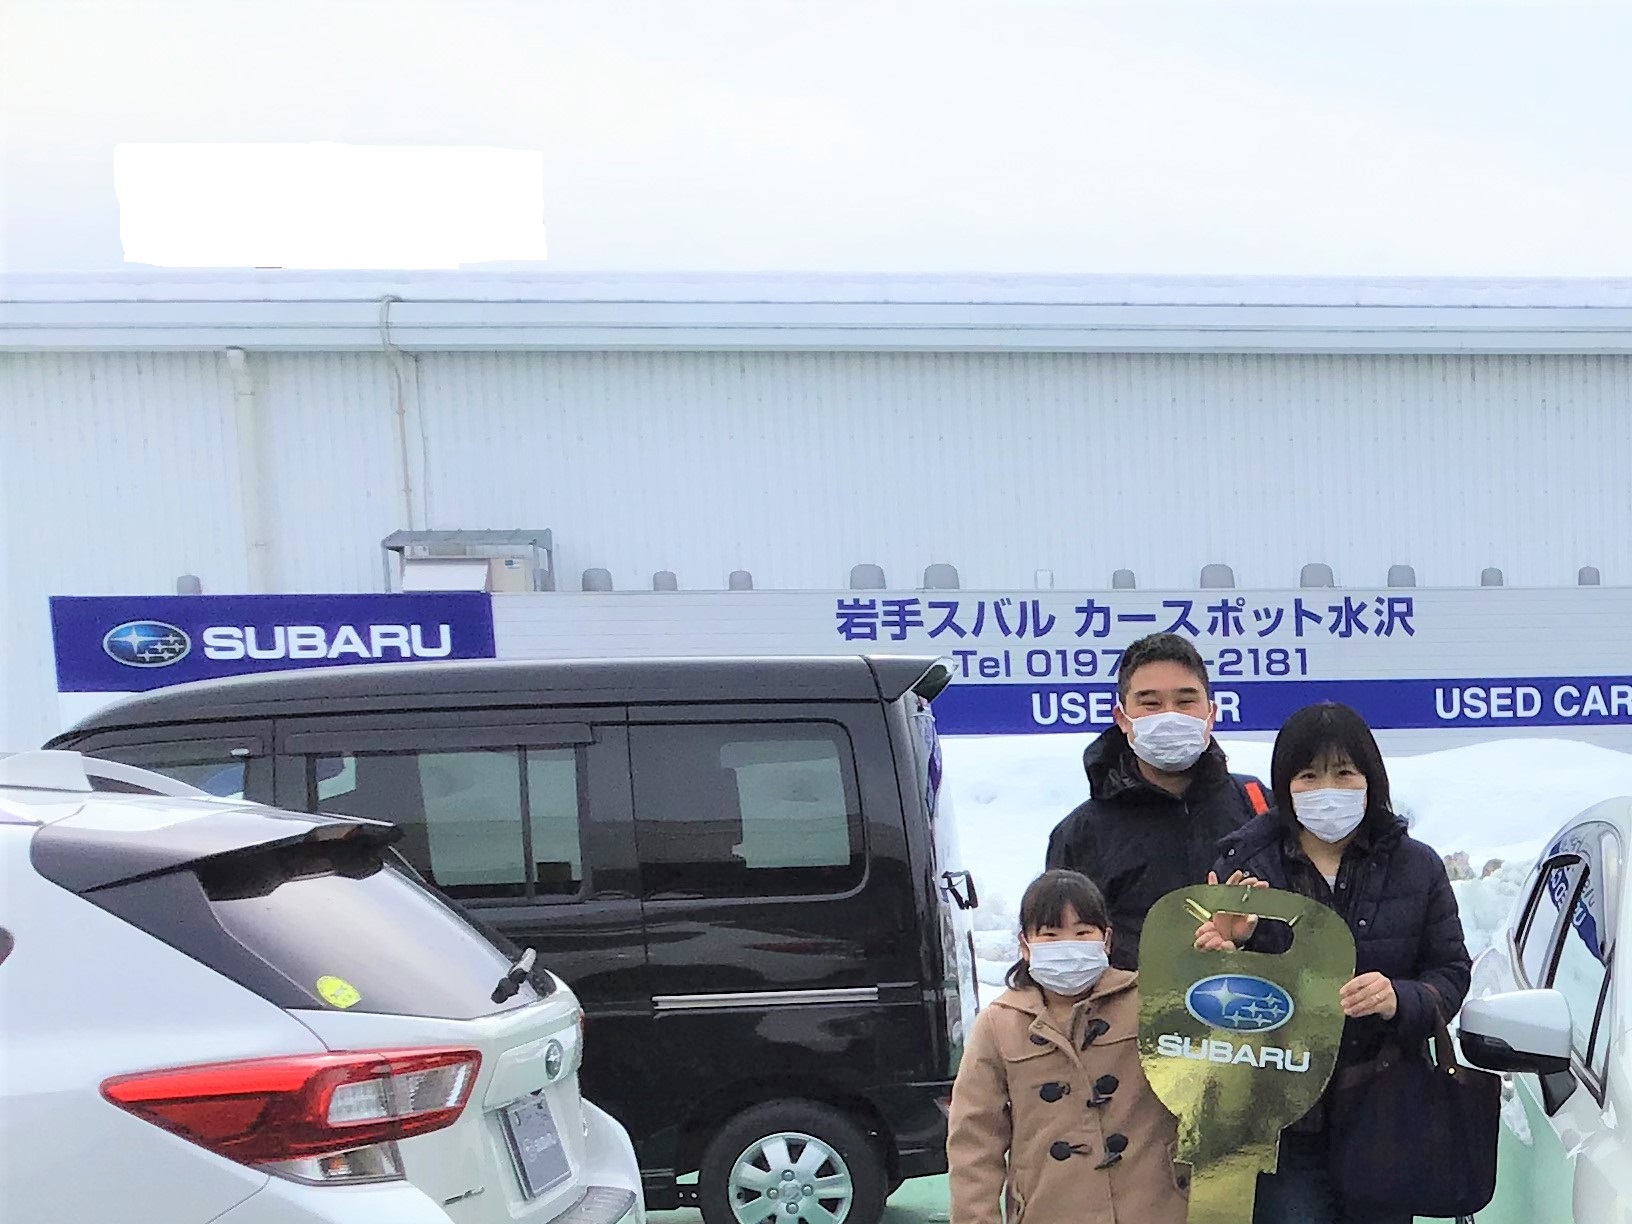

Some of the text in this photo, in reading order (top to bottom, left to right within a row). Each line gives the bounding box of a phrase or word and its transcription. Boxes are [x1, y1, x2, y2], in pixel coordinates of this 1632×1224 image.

[835, 596, 1415, 641] 岩手スバル カースポット水沢
[203, 624, 451, 661] SUBARU
[952, 649, 1012, 678] Tel
[1031, 691, 1119, 725] USE
[1435, 686, 1542, 720] USED
[1157, 1034, 1310, 1073] SUBARU
